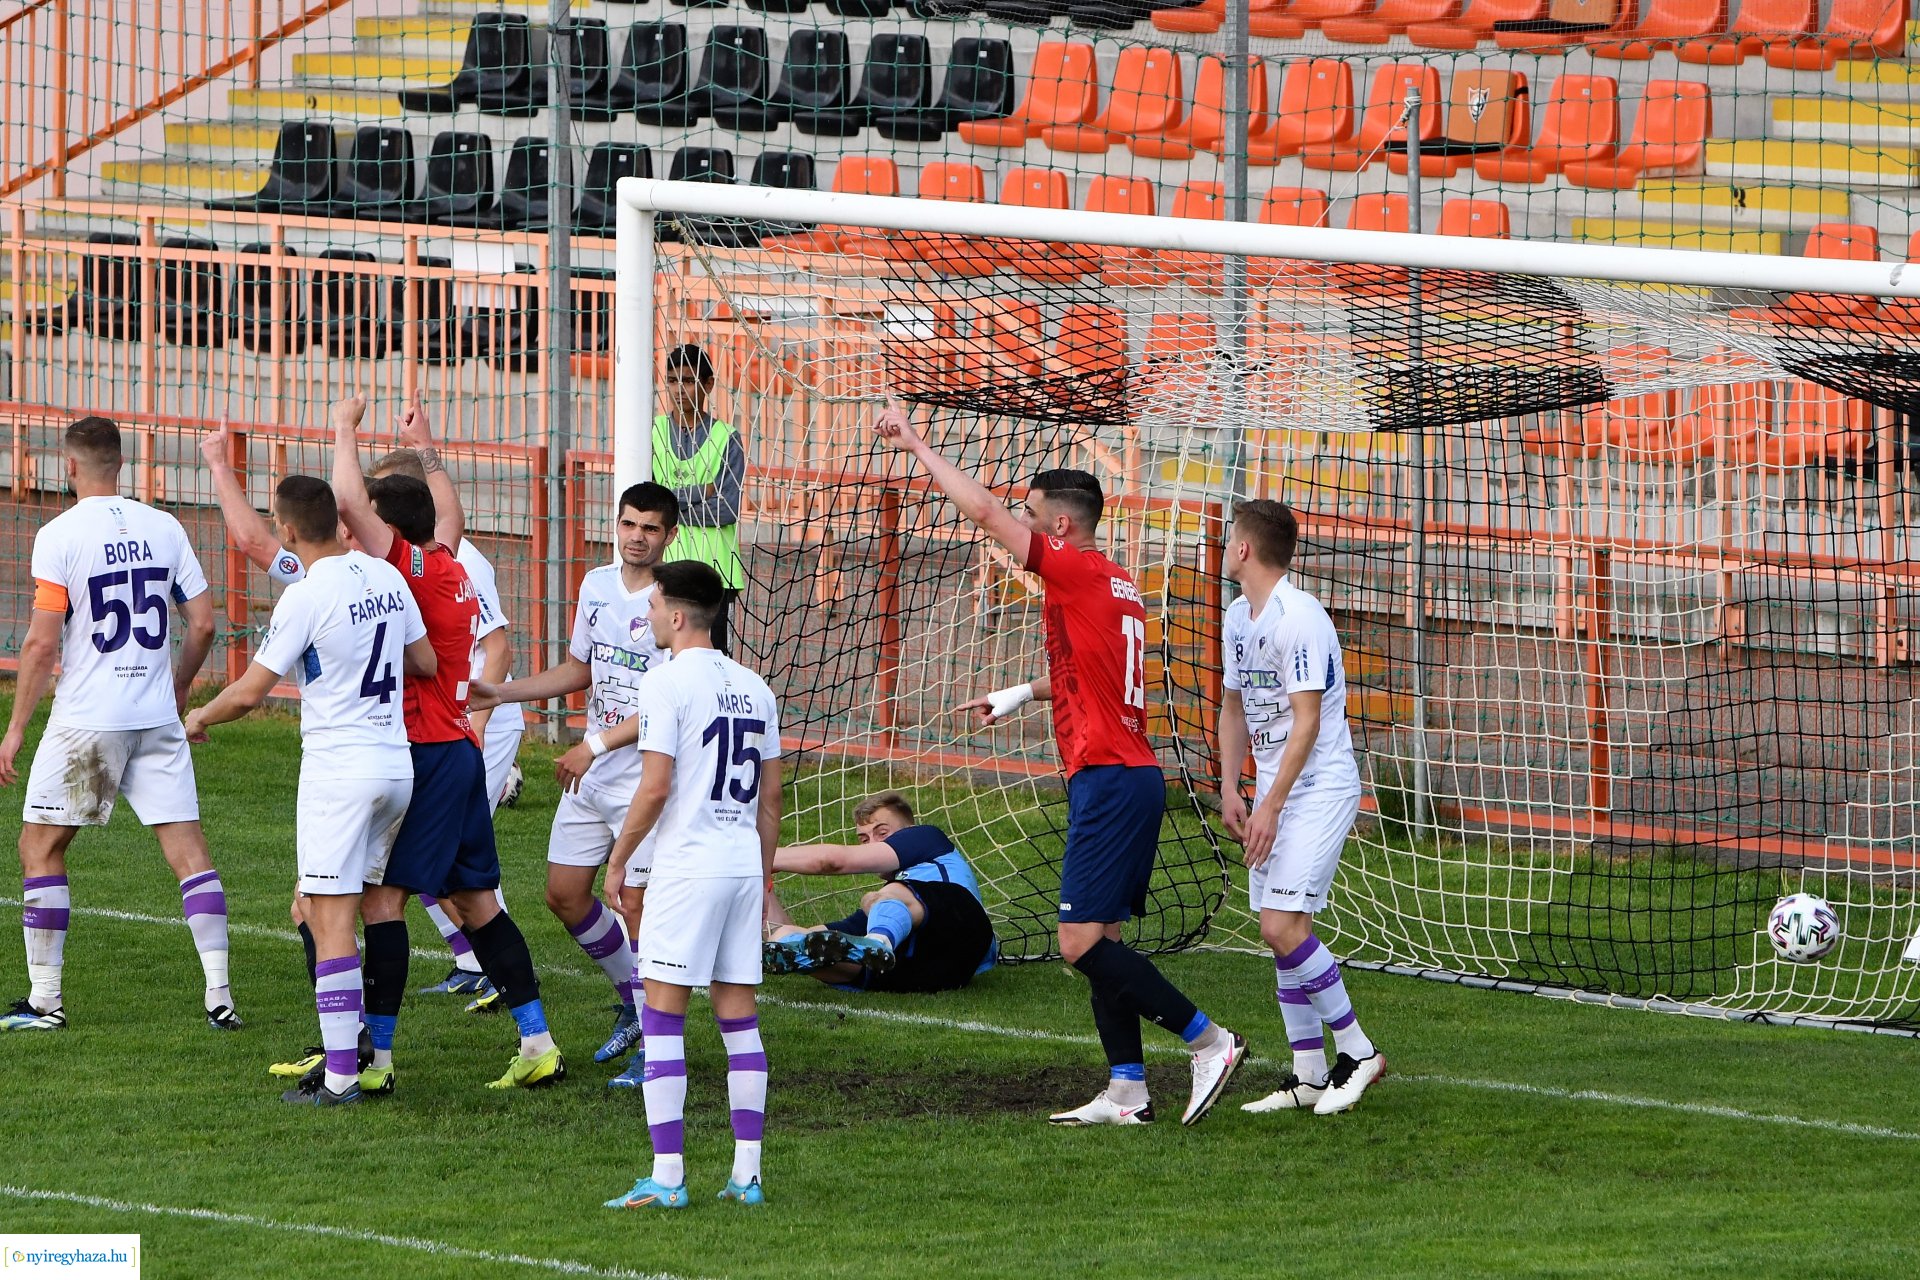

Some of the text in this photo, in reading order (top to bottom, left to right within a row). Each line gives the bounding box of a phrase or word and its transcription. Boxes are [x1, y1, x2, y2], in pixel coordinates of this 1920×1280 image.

[103, 539, 154, 566] BORA
[87, 566, 171, 655] 55
[348, 589, 406, 627] FARKAS
[588, 607, 600, 627] 6
[359, 621, 398, 705] 4
[1121, 614, 1146, 710] 13
[1235, 643, 1244, 663] 8
[716, 687, 753, 715] MÁRIS
[701, 715, 767, 804] 15
